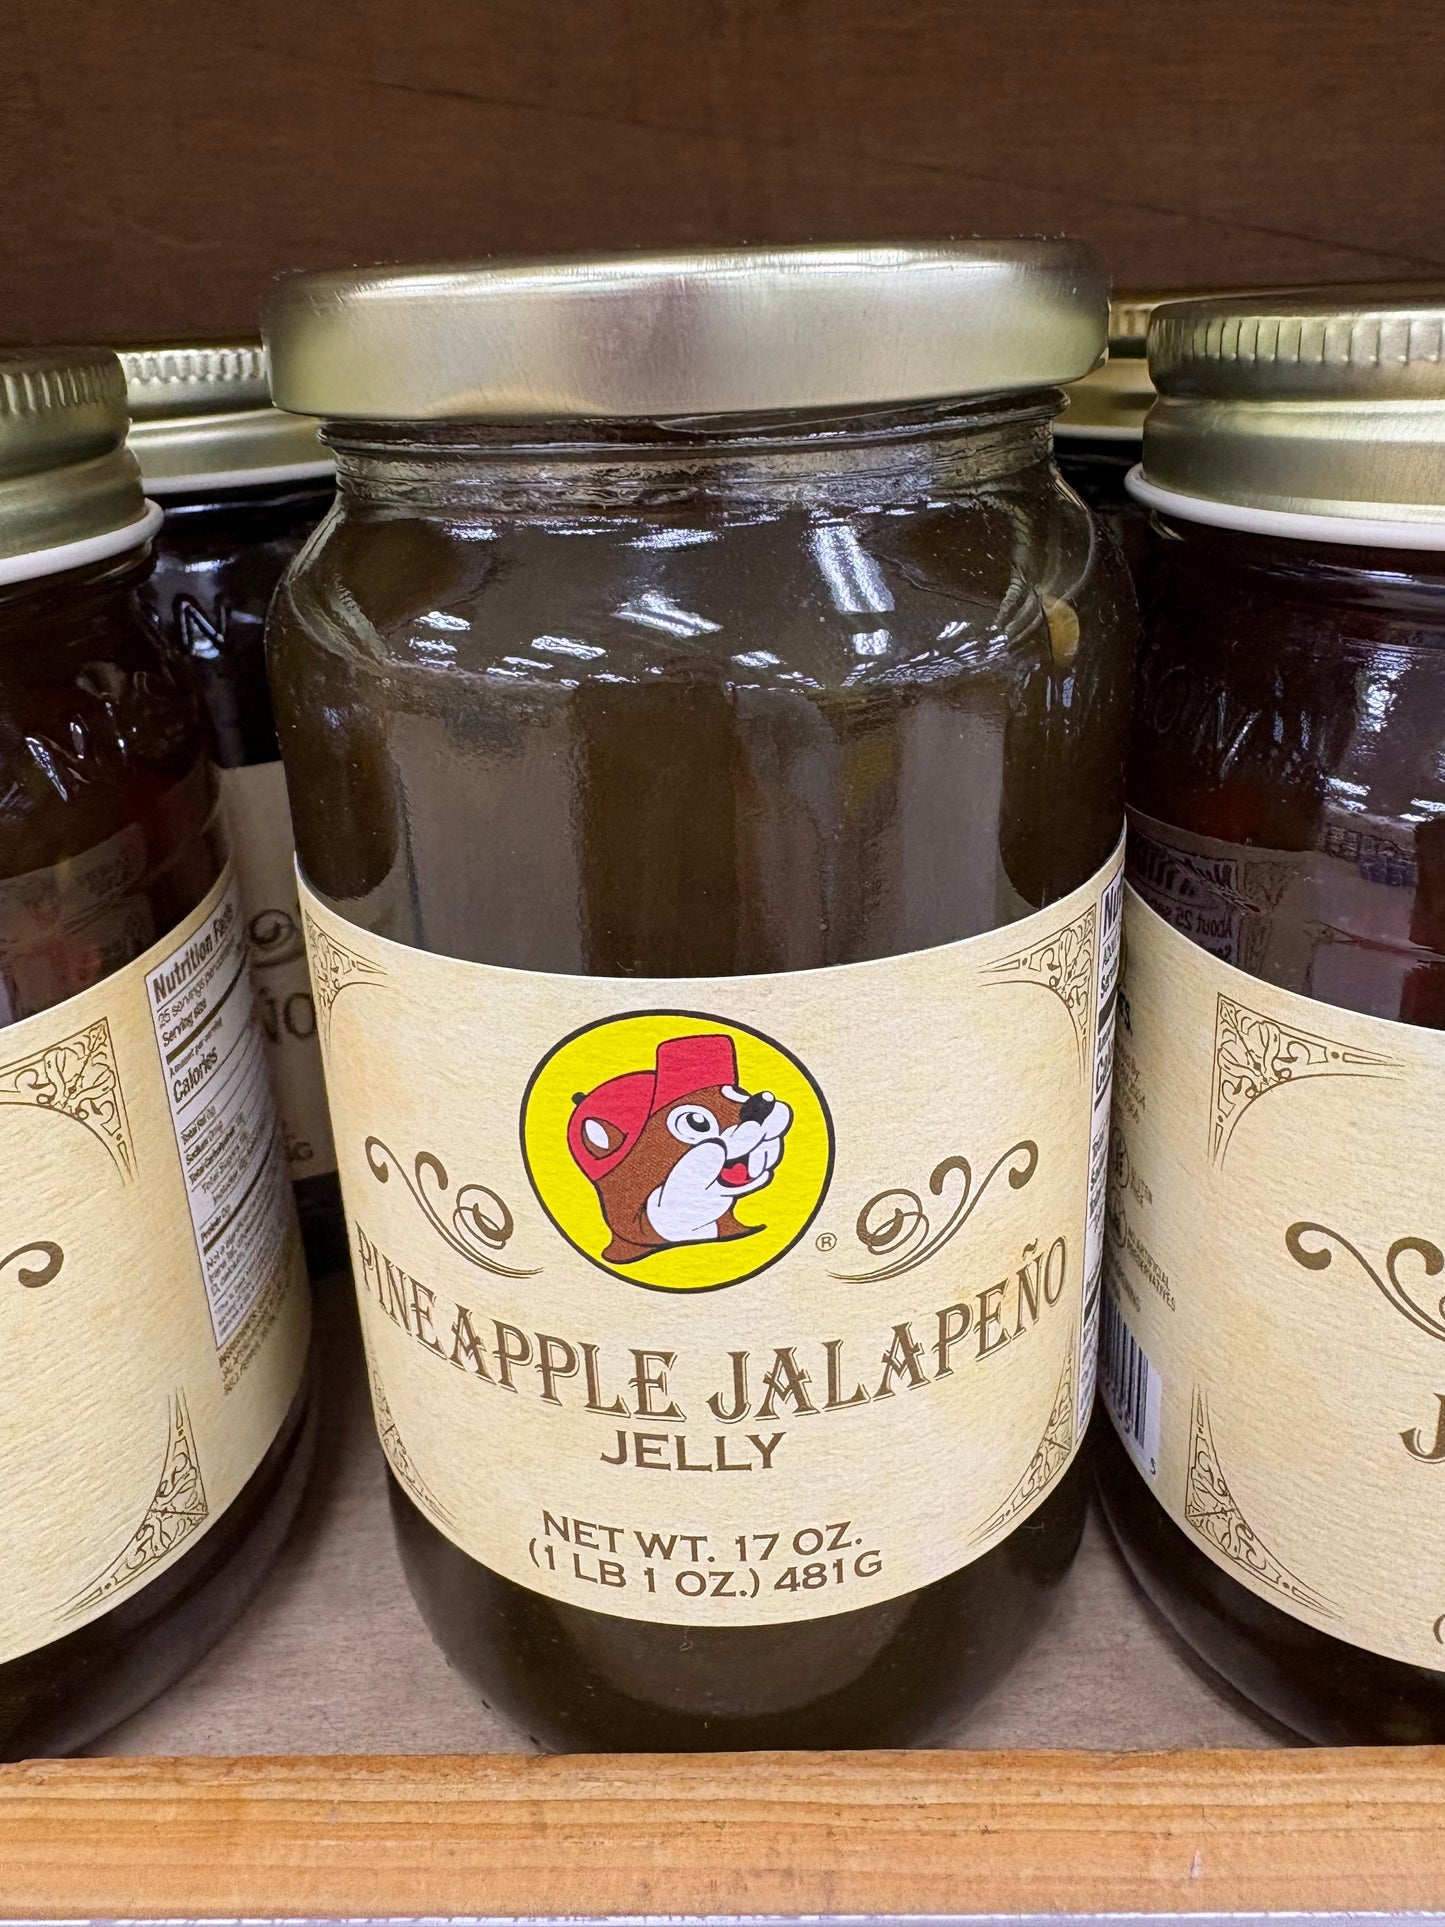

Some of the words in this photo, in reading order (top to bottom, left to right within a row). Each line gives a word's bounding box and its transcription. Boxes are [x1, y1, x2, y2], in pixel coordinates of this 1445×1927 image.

[153, 933, 213, 1004] Nutrition
[162, 1011, 194, 1048] Serving
[173, 1046, 218, 1103] Calories
[355, 1220, 687, 1422] PINEAPPLE
[708, 1234, 1067, 1424] JALAPEÑO
[600, 1430, 787, 1472] JELLY
[542, 1510, 625, 1553] NET
[633, 1531, 716, 1563] WT.
[735, 1532, 780, 1562] 17
[792, 1520, 863, 1556] OZ.
[529, 1538, 556, 1571] (1
[573, 1553, 627, 1588] LB
[644, 1567, 657, 1593] 1
[675, 1567, 760, 1599] OZ.)
